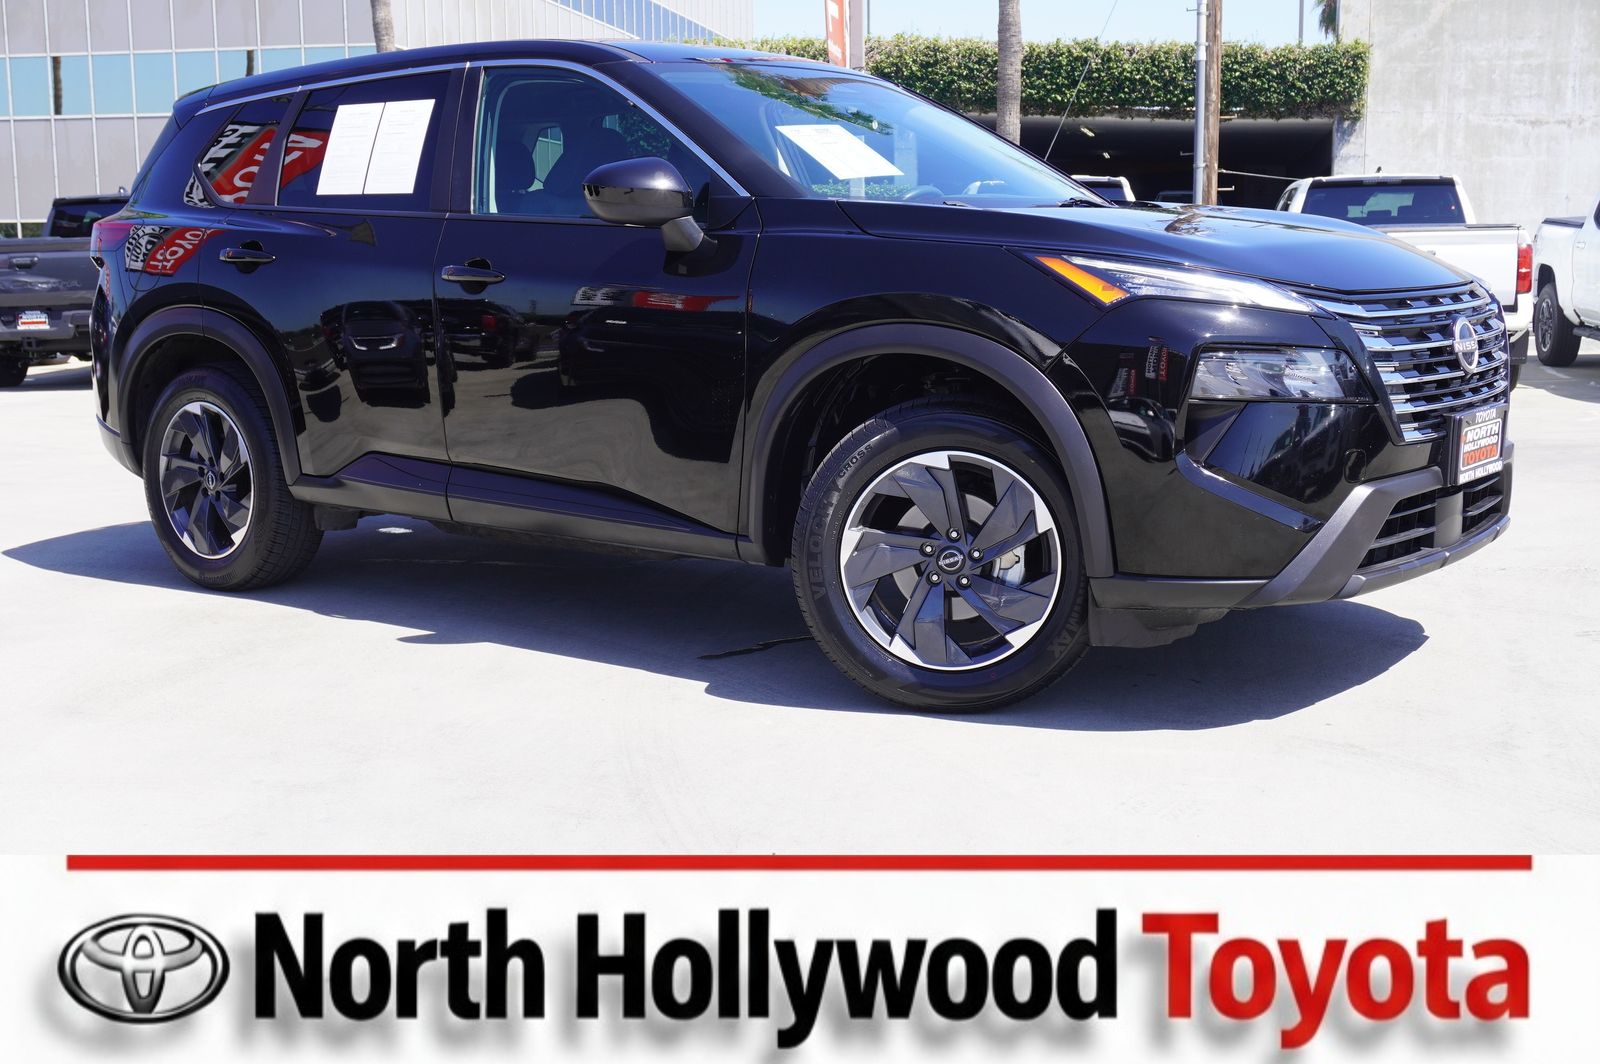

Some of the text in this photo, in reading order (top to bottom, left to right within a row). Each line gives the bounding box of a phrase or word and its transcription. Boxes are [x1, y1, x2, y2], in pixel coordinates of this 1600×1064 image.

[1455, 340, 1478, 351] NISS
[1475, 408, 1497, 424] TOYOTA
[1466, 422, 1500, 443] NORTH
[1464, 435, 1498, 453] HOLLYWOOD
[837, 443, 873, 478] CROSS
[1463, 444, 1497, 466] TOYOTA
[1475, 461, 1503, 478] HOLLYWOOD
